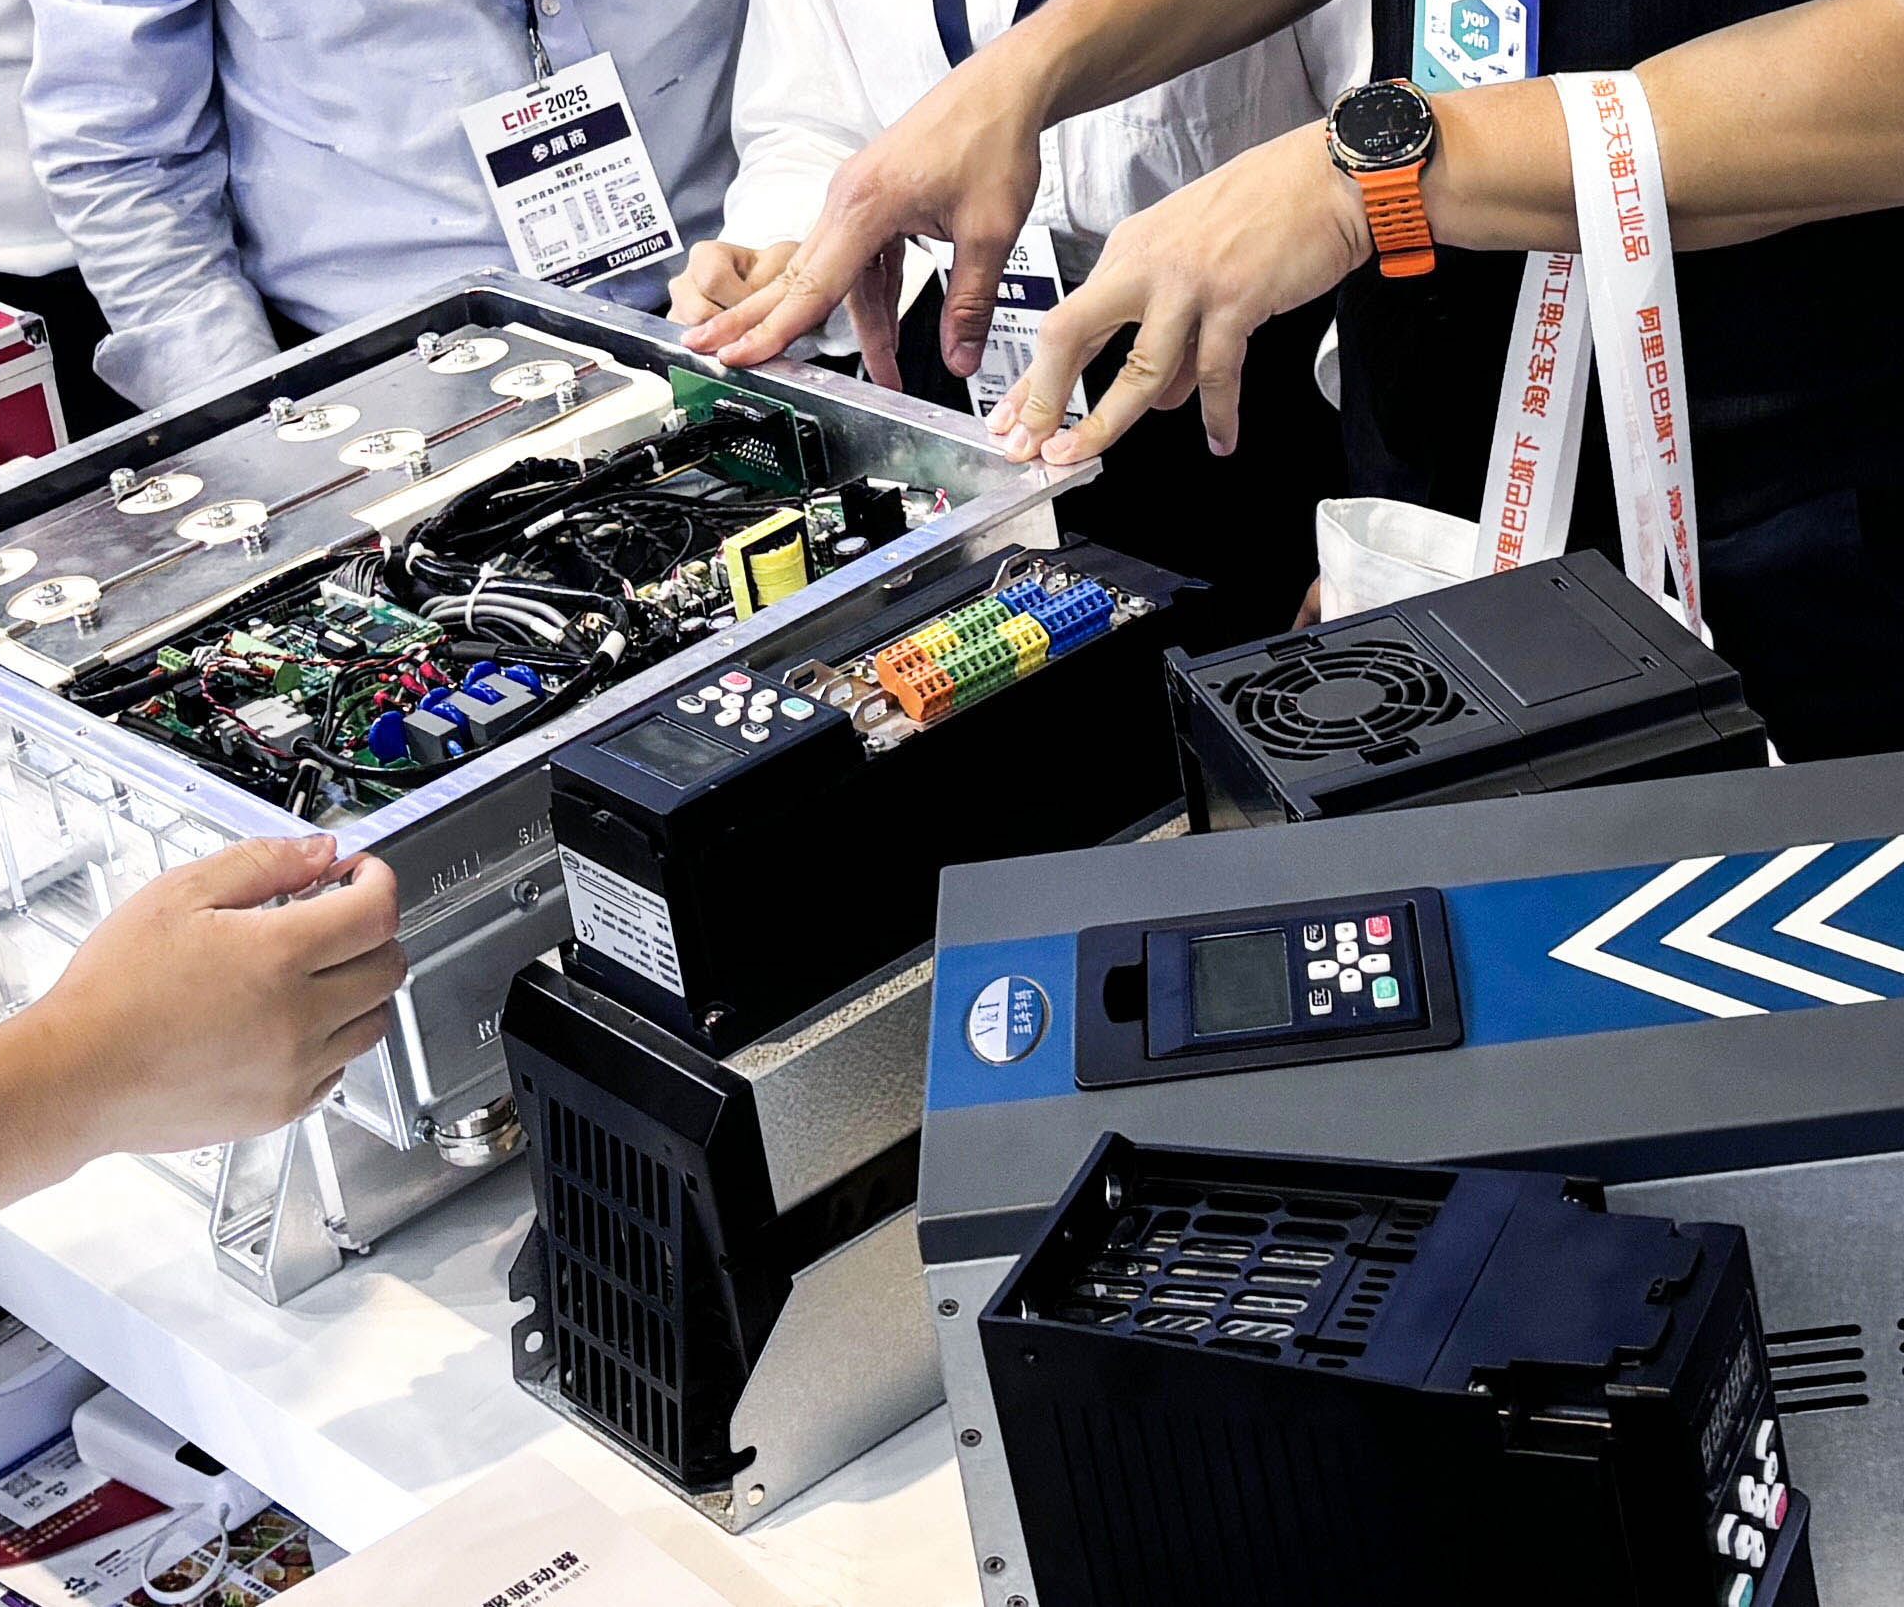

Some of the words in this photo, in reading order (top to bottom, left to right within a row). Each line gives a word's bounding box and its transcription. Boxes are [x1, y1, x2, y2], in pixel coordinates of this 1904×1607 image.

[1460, 9, 1490, 29] you
[501, 101, 544, 131] CIIF
[545, 84, 588, 114] 2025
[531, 128, 588, 163] 参展商
[1588, 77, 1652, 264] 淘宝天猫工业品
[606, 235, 667, 269] EXHIBITOR
[996, 281, 1026, 301] 展商
[1635, 305, 1679, 466] 阿里巴巴旗下
